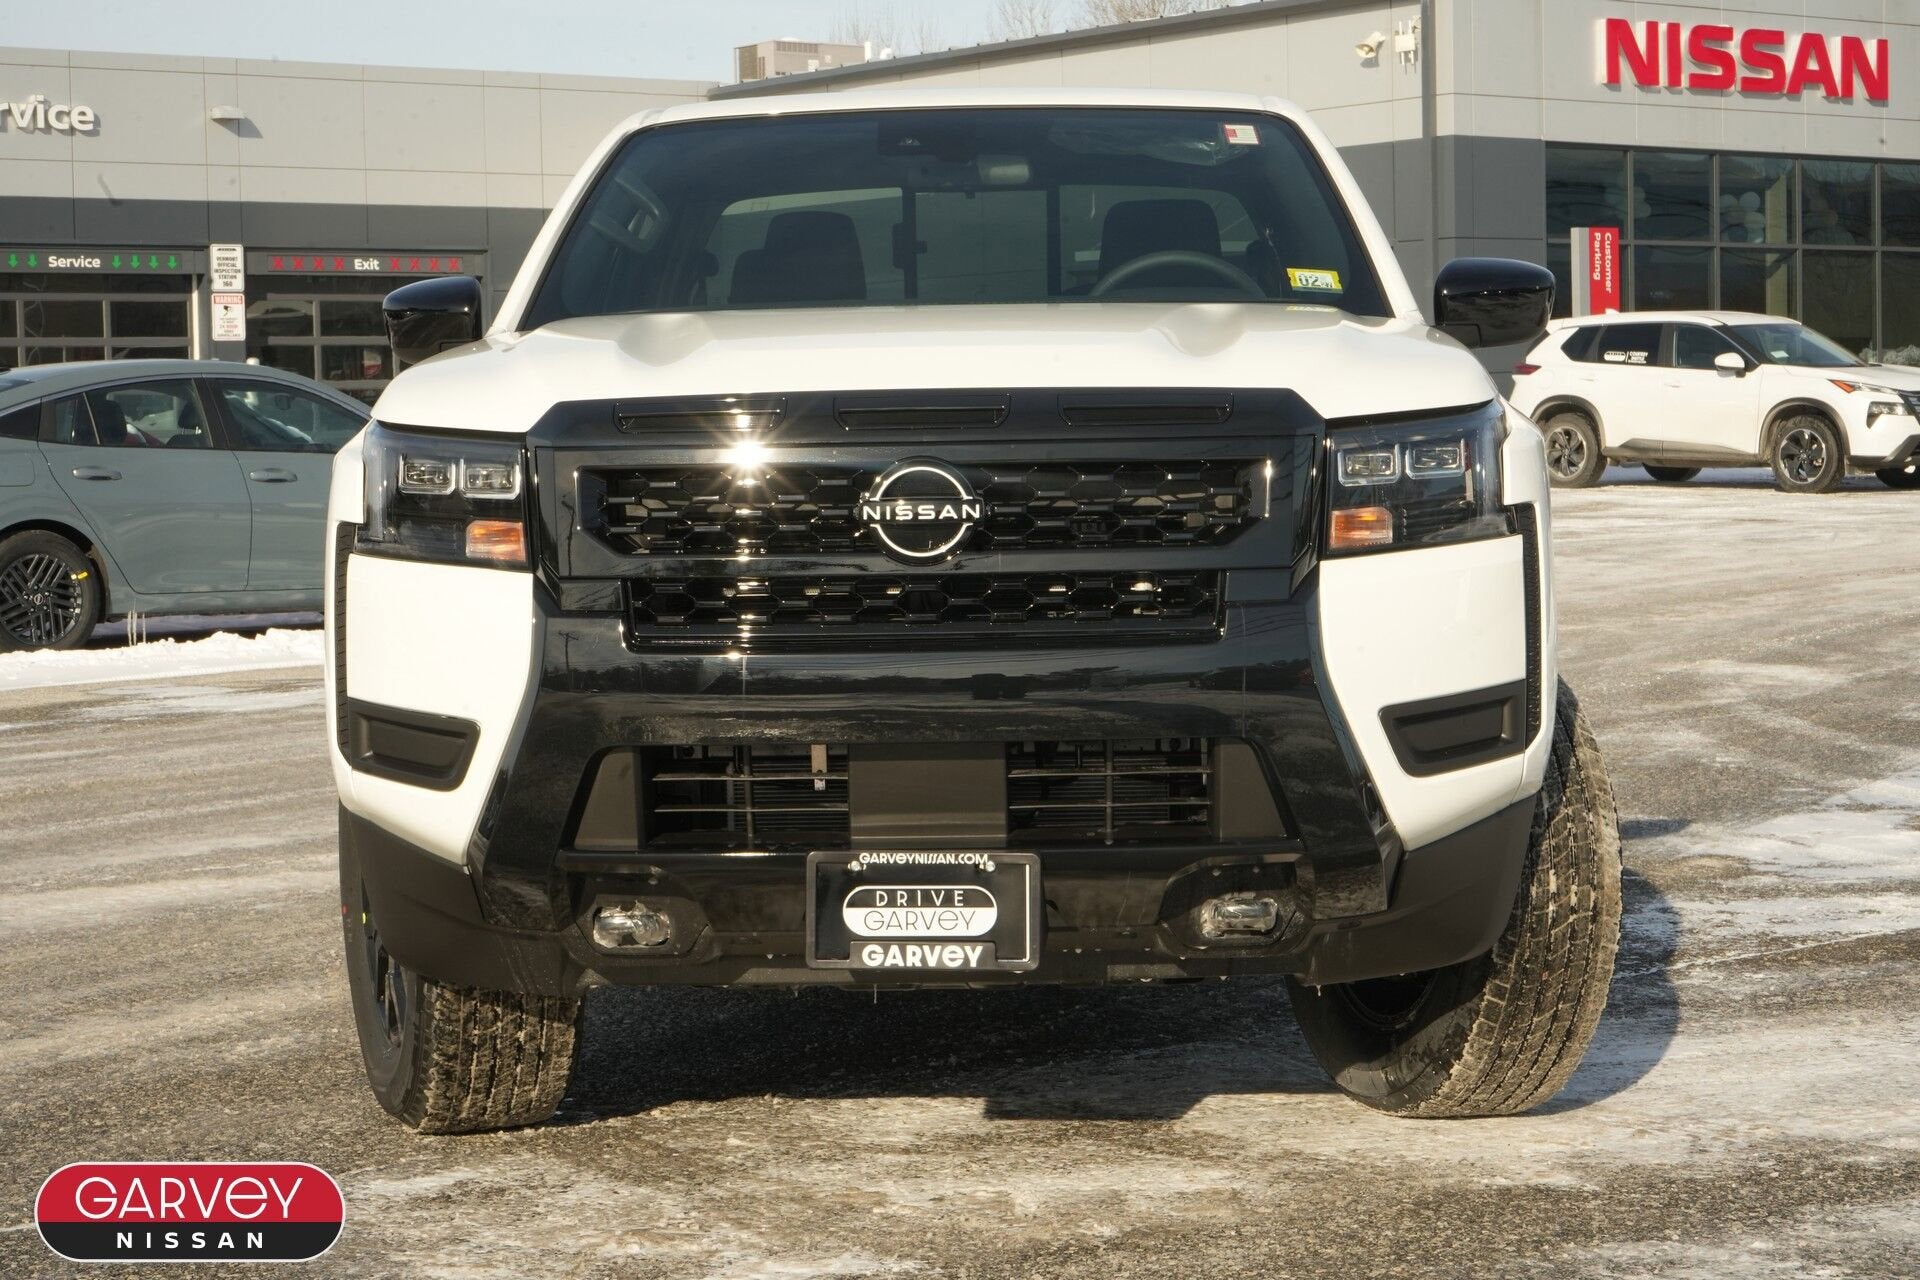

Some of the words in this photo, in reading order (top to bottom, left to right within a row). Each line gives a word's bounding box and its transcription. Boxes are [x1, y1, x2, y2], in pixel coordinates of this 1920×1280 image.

[1606, 18, 1889, 102] NISSAN
[48, 255, 101, 268] Service
[354, 258, 380, 271] Exit
[1593, 232, 1601, 281] Parking
[214, 295, 242, 304] WARNING
[863, 504, 980, 520] NISSAN
[876, 890, 964, 906] DRIVE
